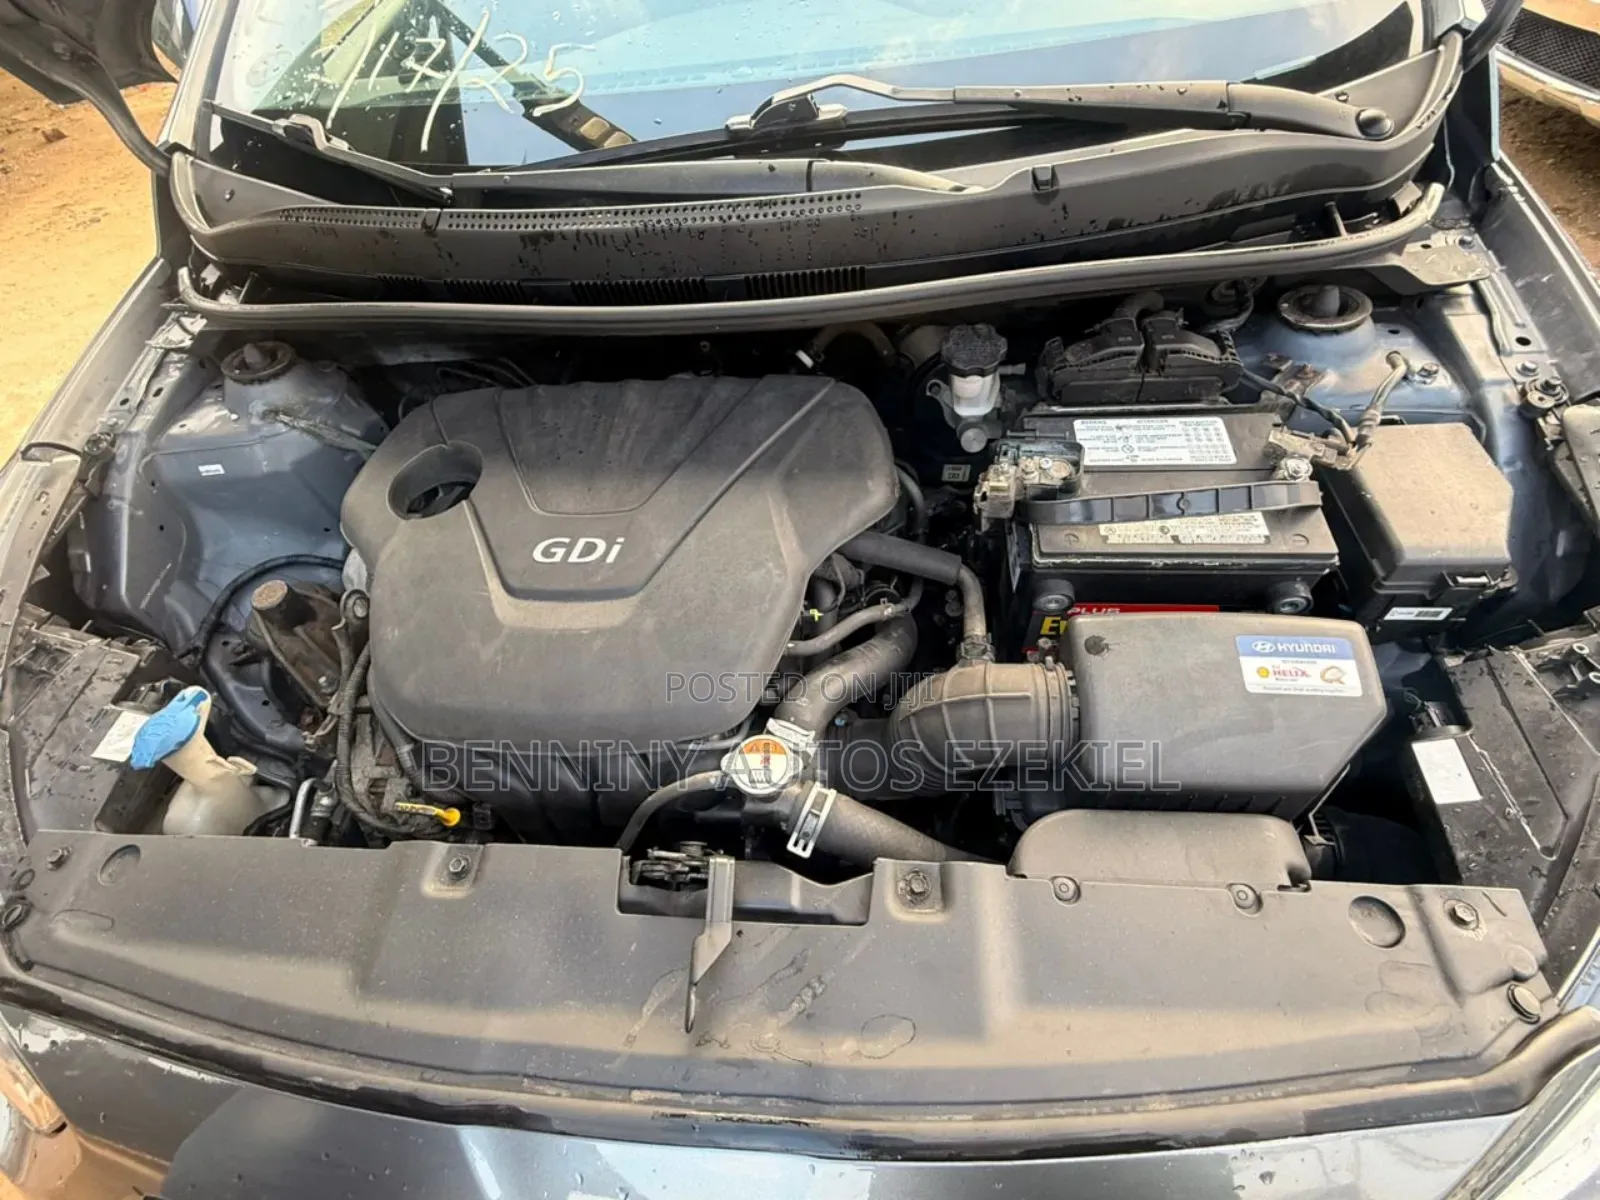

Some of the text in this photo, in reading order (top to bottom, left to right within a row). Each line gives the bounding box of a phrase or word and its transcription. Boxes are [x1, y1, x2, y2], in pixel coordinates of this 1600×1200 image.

[532, 537, 625, 563] GDi
[1067, 606, 1120, 616] PLUS
[1278, 643, 1336, 654] HYUNDAI
